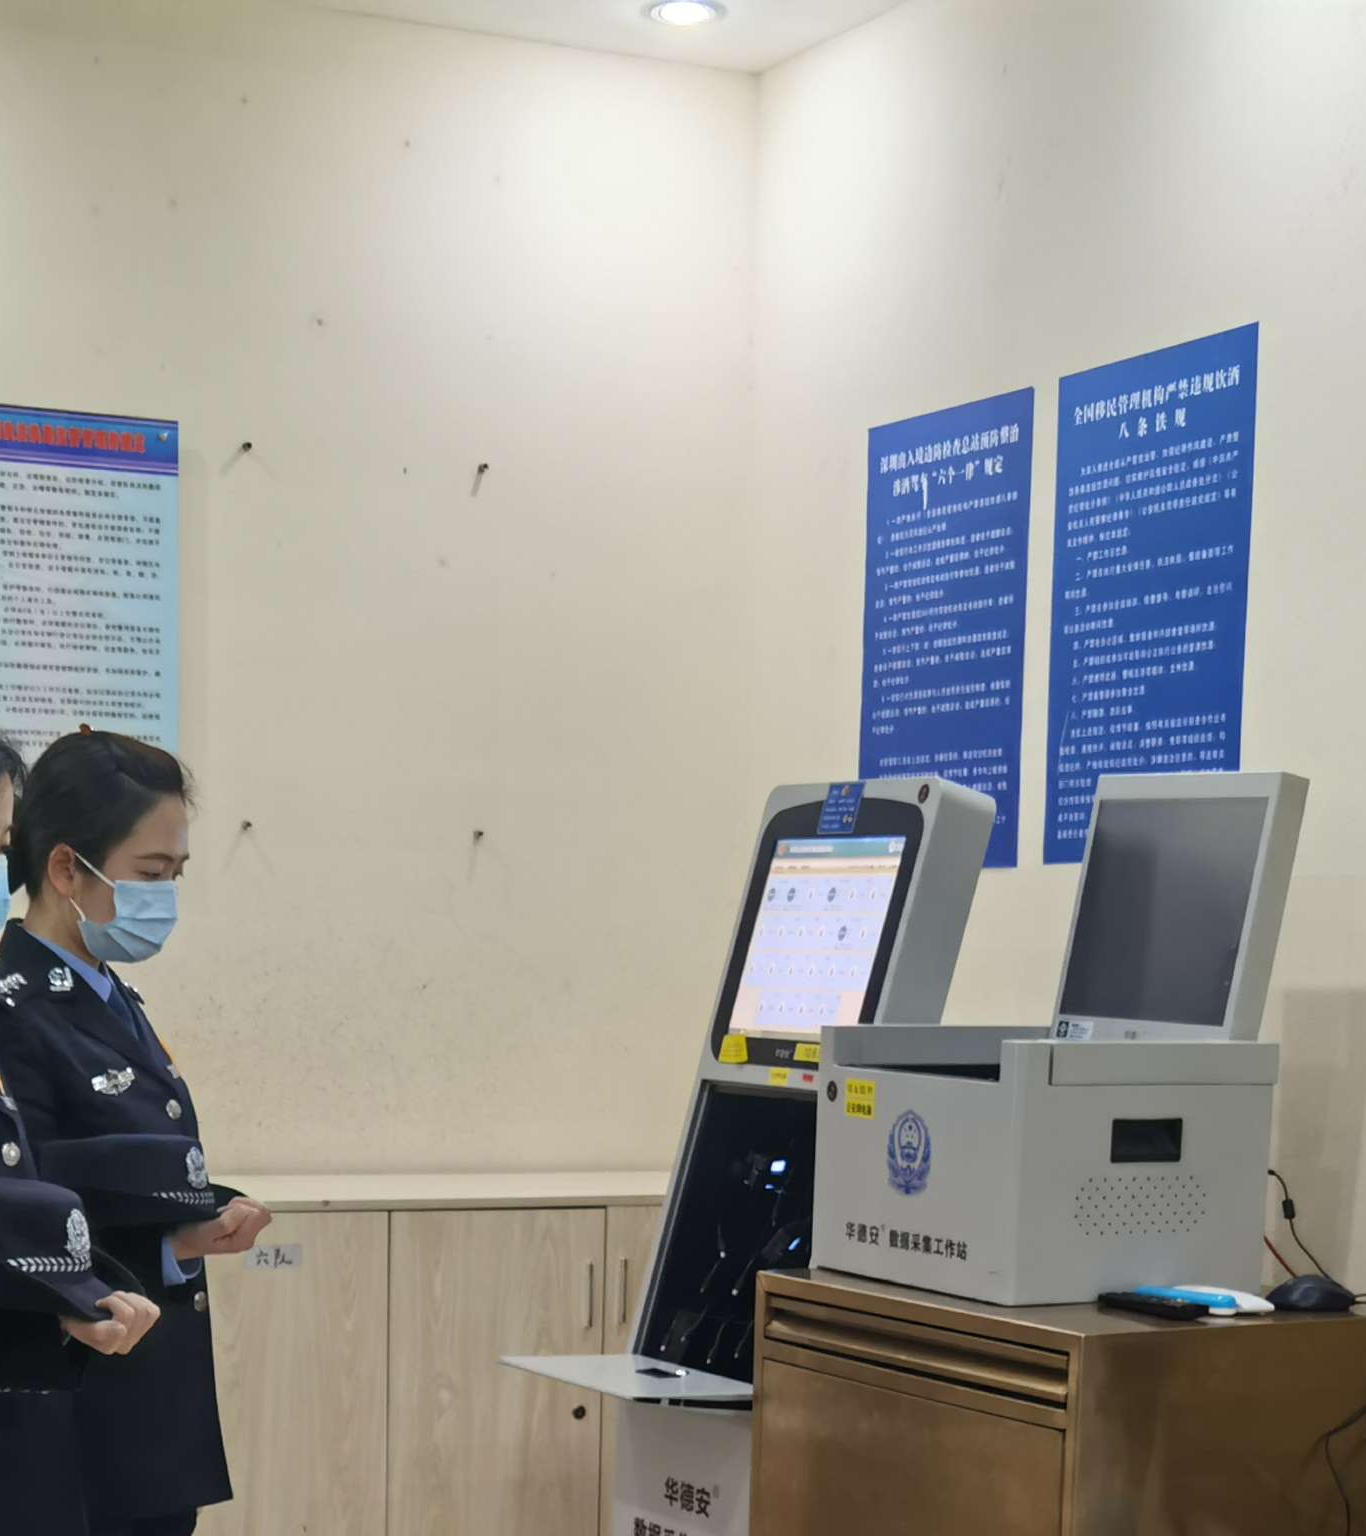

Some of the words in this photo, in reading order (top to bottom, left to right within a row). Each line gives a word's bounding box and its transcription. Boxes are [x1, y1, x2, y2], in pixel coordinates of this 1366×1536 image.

[1073, 364, 1242, 426] 全国移民管理机构严禁违规饮酒
[1118, 407, 1188, 440] 八条铁规
[844, 1220, 880, 1248] 华德安
[888, 1228, 969, 1262] 数据采集工作站
[663, 1476, 712, 1519] 华德安
